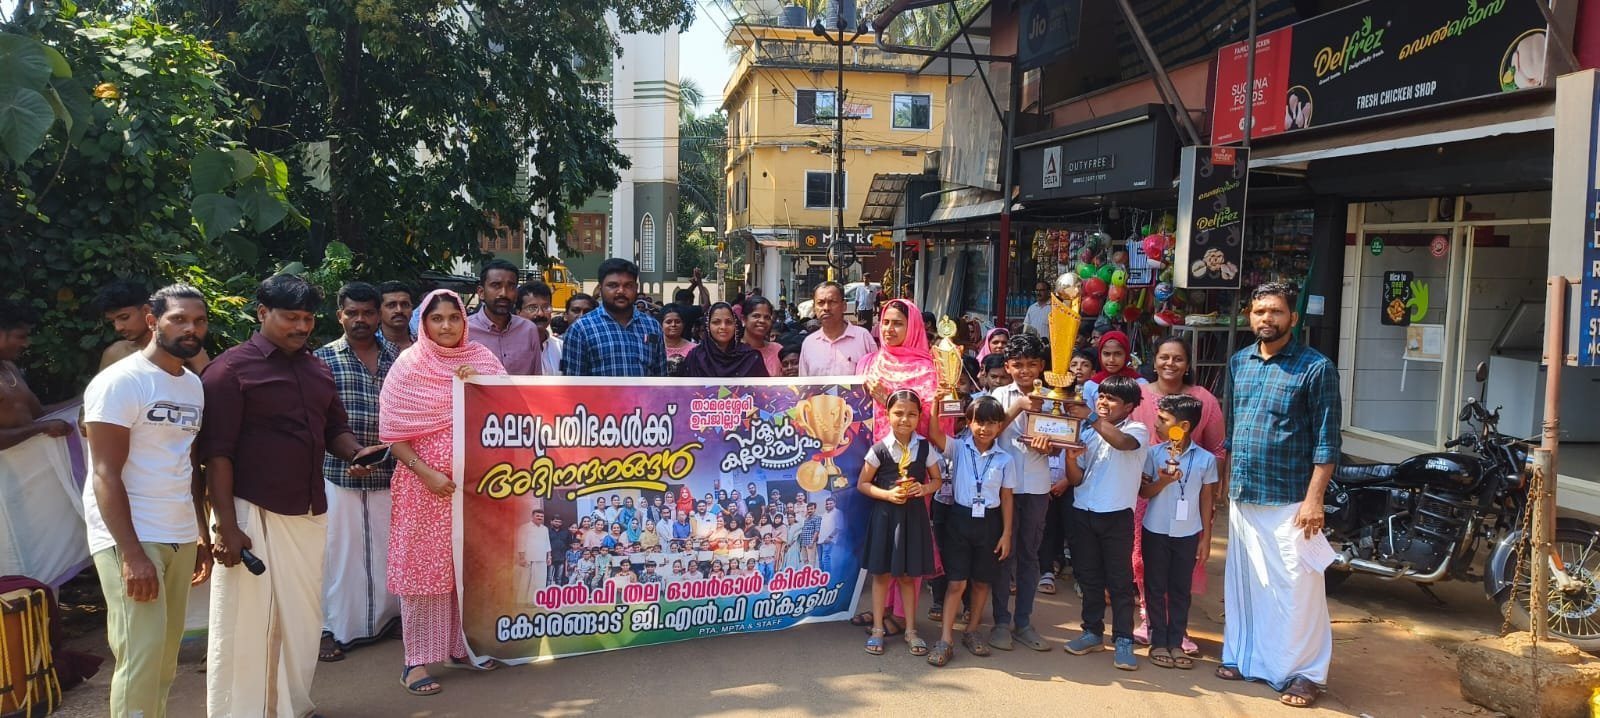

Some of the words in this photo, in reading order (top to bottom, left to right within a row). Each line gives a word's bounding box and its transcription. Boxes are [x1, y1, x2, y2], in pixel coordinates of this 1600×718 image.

[1029, 13, 1047, 40] Jio
[1313, 28, 1385, 76] Delfrez
[1231, 77, 1268, 96] SUNA
[1233, 90, 1264, 106] FODS
[1356, 93, 1379, 110] FRESH
[1380, 85, 1413, 105] CHICKEN
[1414, 80, 1437, 98] SHOP
[1196, 211, 1239, 230] Delfrez
[822, 233, 873, 244] MTR
[481, 403, 678, 457] കലാപ്രതിഭകൾക്ക്
[476, 443, 703, 499] അഭിനന്ദനങ്ങൾ
[536, 580, 615, 609] എൽ.പി
[624, 583, 659, 603] തല
[769, 566, 829, 592] കിരീടം
[498, 607, 627, 641] കോരങ്ങാട്
[754, 583, 844, 618] സ്കൂളിന്
[721, 624, 744, 632] MPTA
[756, 618, 783, 628] STAFF
